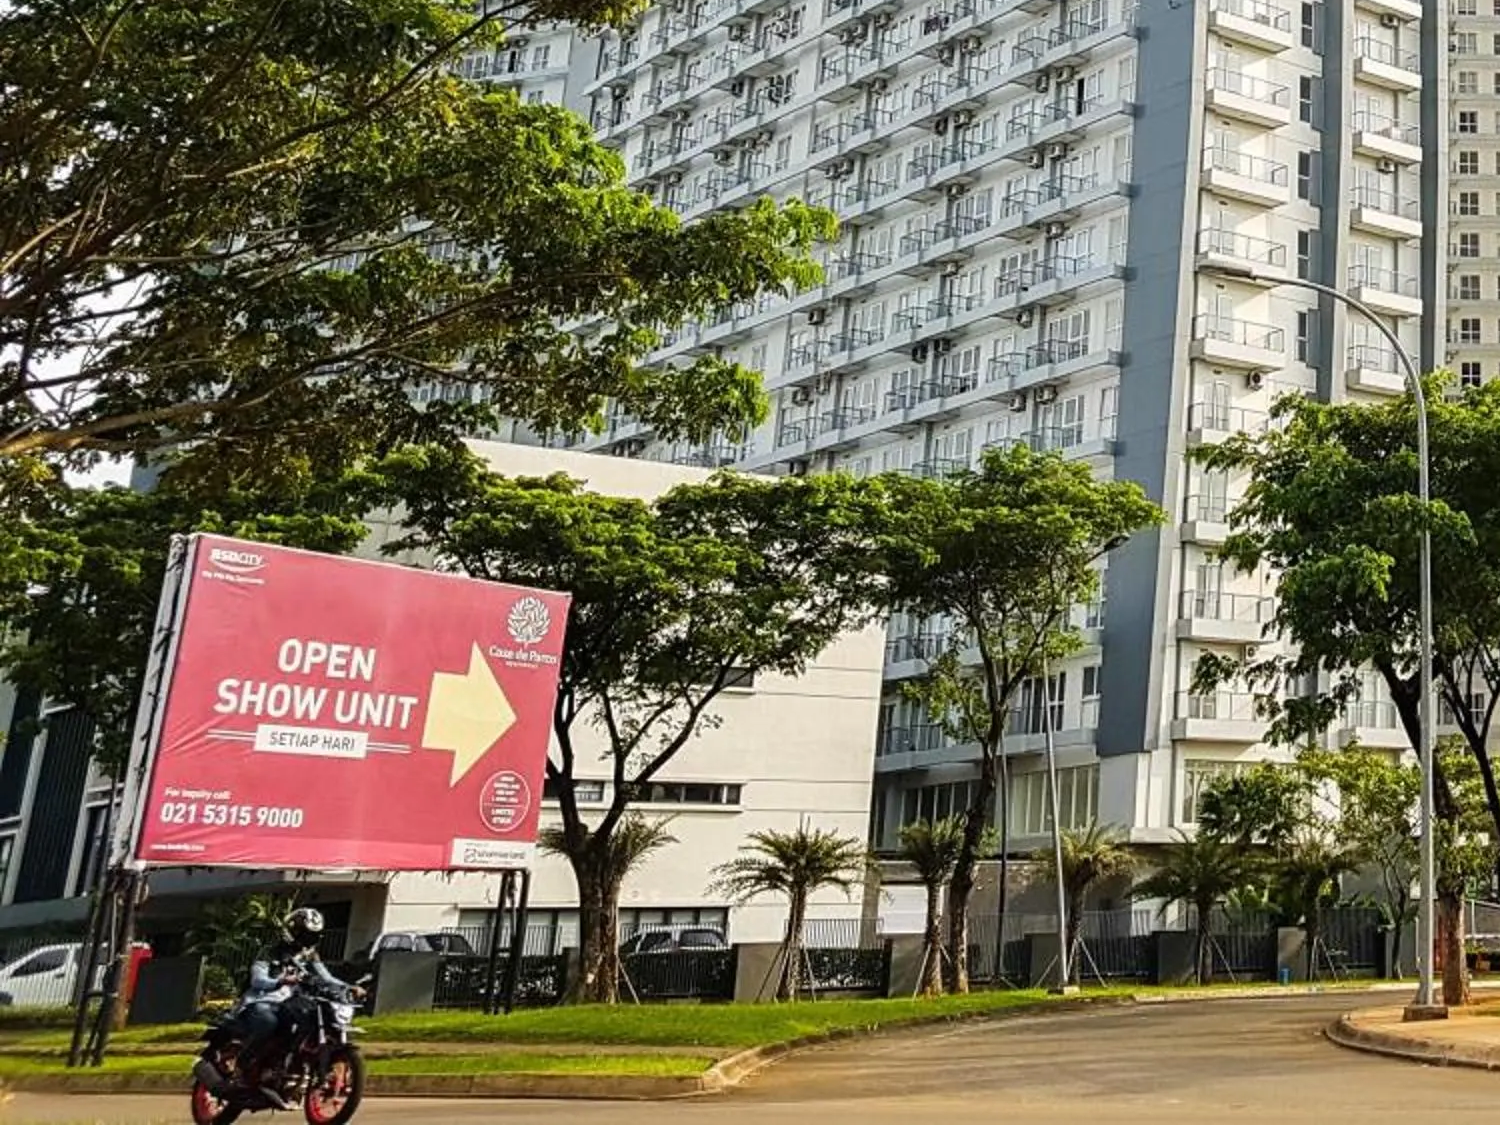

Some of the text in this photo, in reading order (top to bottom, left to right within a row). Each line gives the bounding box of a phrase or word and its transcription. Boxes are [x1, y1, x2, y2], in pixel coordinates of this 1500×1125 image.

[277, 638, 377, 681] OPEN
[213, 678, 419, 730] SHOW UNIT
[268, 731, 356, 751] SETIAP HARI
[160, 802, 304, 828] 021 5315 9000
